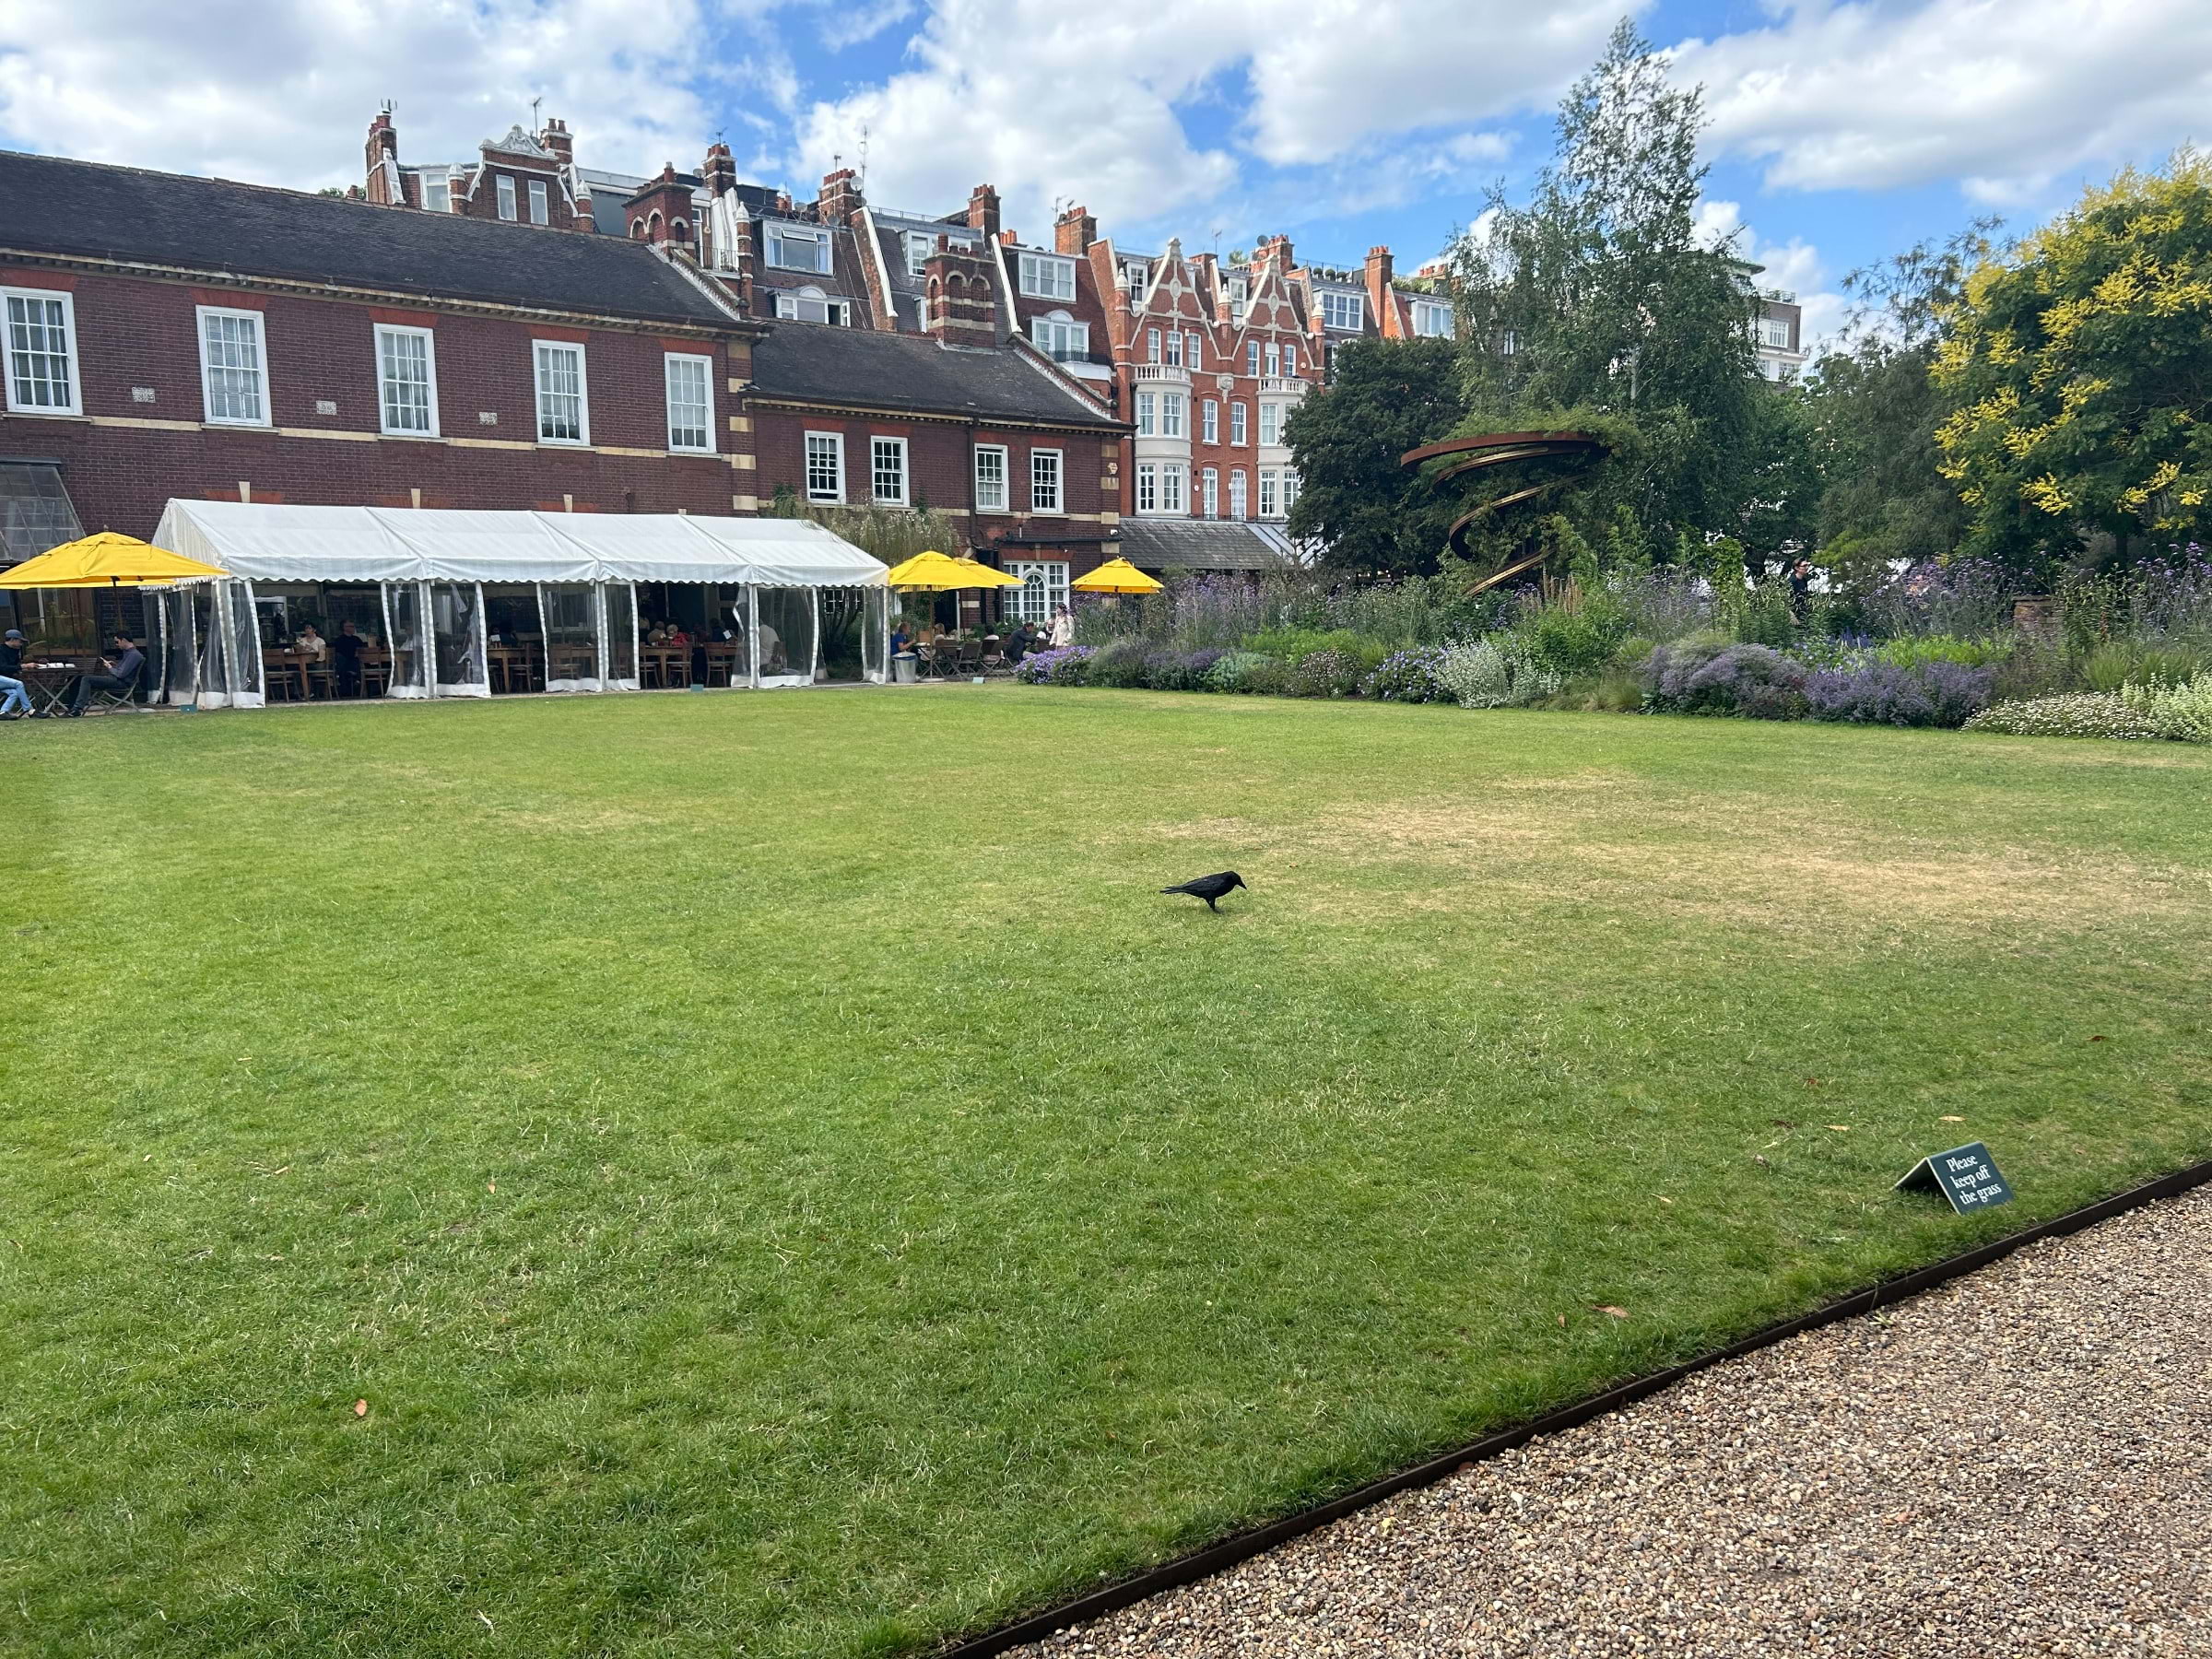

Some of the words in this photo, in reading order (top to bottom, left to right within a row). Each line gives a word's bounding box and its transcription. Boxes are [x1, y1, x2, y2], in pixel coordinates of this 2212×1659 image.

[1946, 1155, 1978, 1172] Please
[1950, 1174, 1976, 1188] keep
[1975, 1164, 1991, 1181] off
[1959, 1190, 1977, 1205] the
[1977, 1182, 2002, 1203] grass
